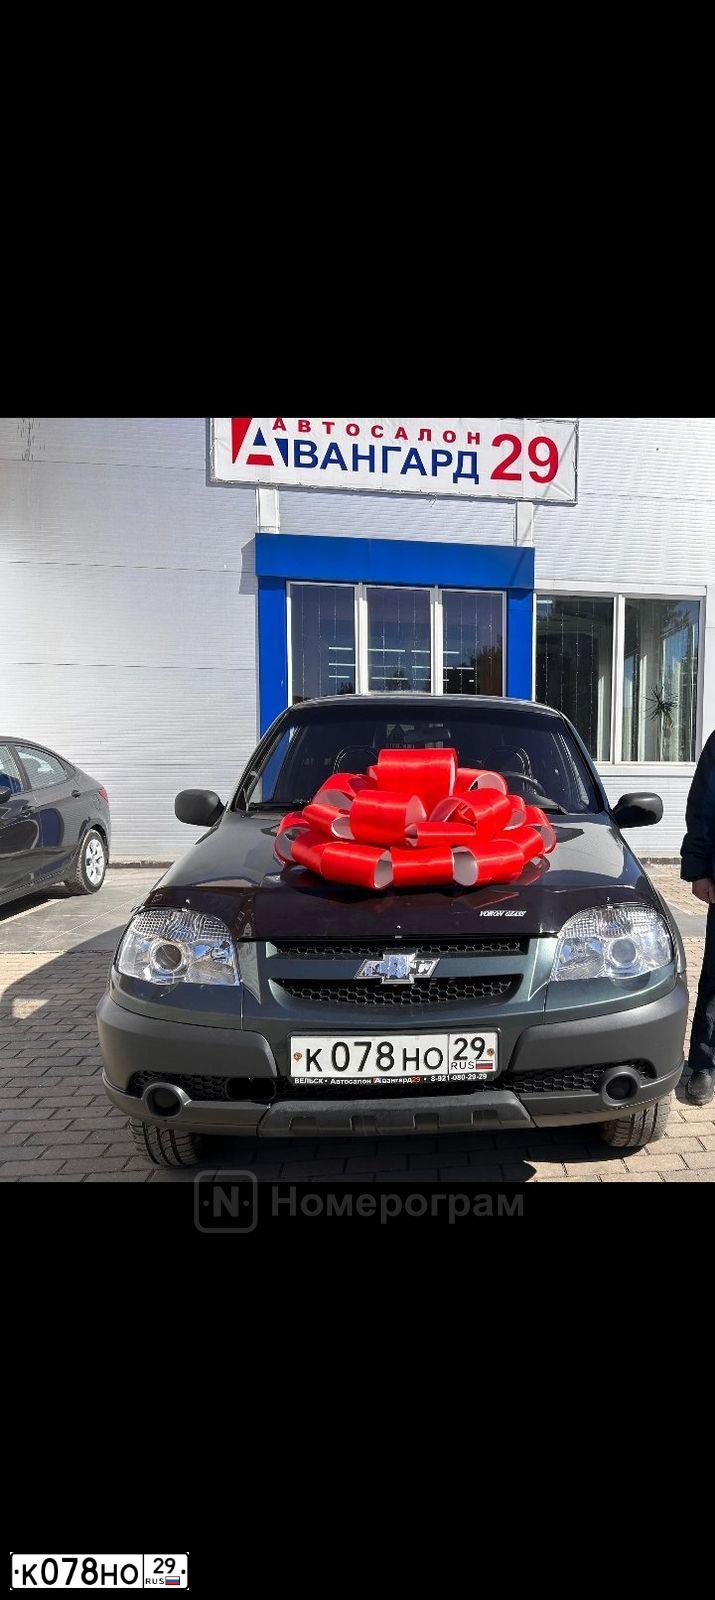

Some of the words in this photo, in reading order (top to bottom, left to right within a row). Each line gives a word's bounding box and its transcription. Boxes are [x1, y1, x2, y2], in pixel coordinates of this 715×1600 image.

[272, 417, 481, 445] АВТОСАЛОН
[232, 418, 480, 485] АВАНГАРД
[489, 433, 559, 484] 29
[453, 1036, 486, 1060] 29
[450, 1060, 476, 1071] RUS
